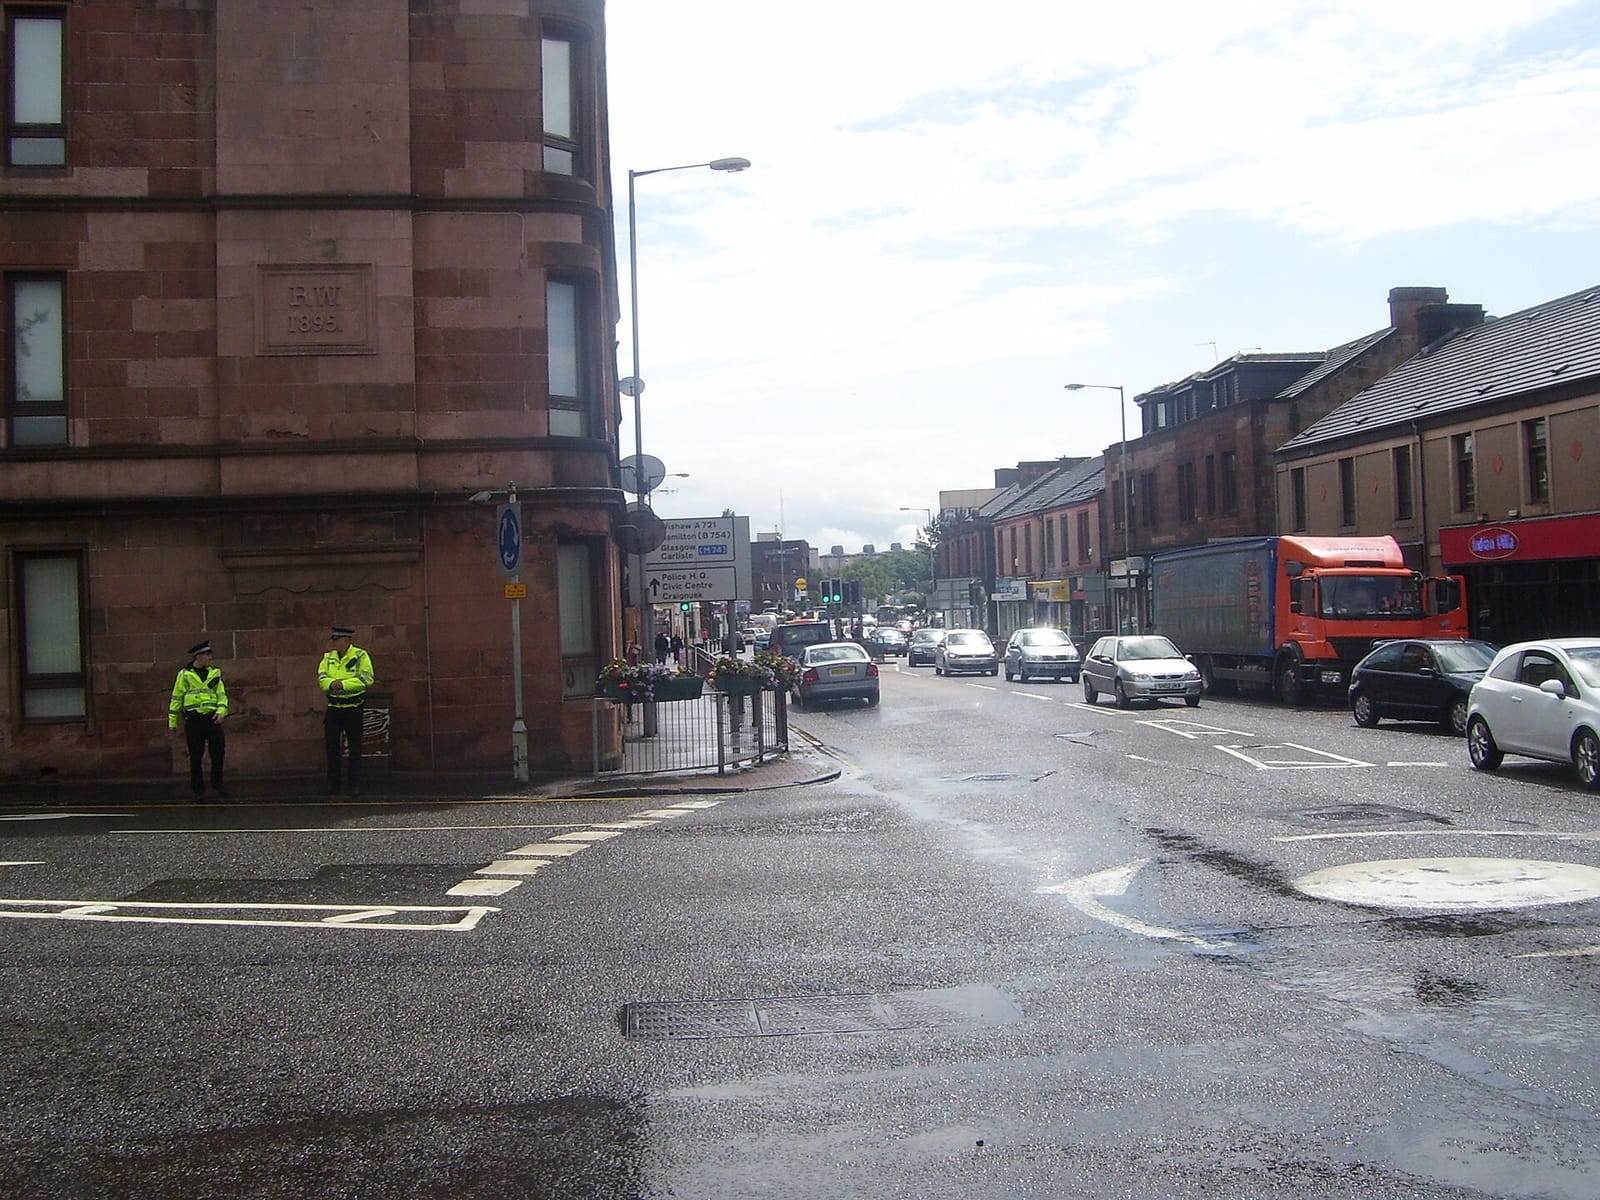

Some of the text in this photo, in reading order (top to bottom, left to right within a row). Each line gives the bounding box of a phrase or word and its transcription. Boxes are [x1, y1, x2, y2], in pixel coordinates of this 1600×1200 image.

[661, 544, 696, 552] Glasgow
[661, 552, 694, 560] Carlisle
[662, 573, 686, 581] Police
[662, 581, 712, 591] Civic Centre
